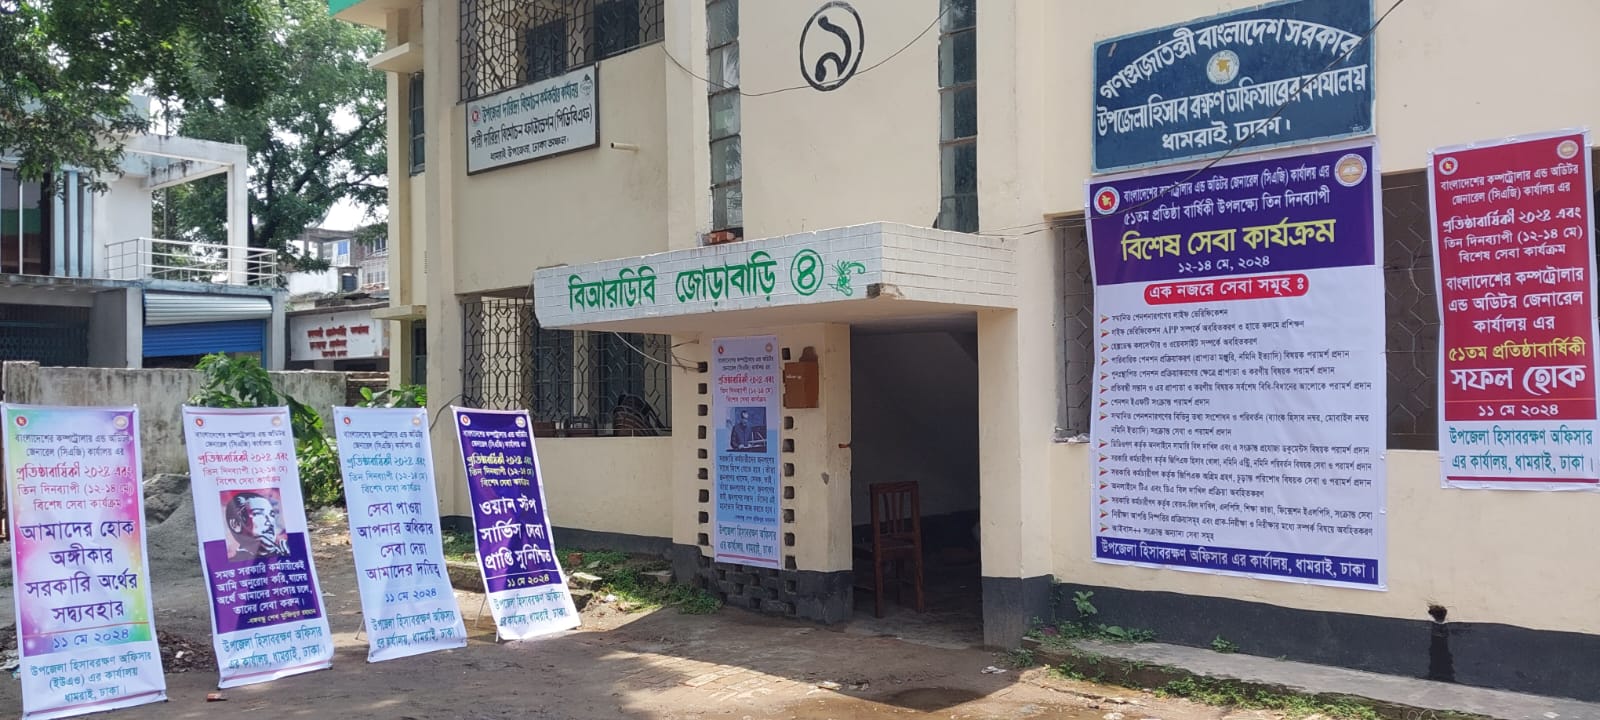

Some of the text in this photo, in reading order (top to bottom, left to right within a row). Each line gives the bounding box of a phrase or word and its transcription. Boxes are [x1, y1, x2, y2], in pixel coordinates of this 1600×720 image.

[808, 9, 858, 86] ৯
[1197, 18, 1283, 50] বাংলাদেশ
[1286, 19, 1363, 61] সরকার
[554, 104, 592, 132] (পিডিবিএফ)
[1097, 101, 1148, 136] উপজেলা
[1148, 93, 1188, 128] হিসাব
[1190, 90, 1225, 120] রক্ষণ
[1226, 77, 1300, 112] অফিসারের
[1124, 188, 1158, 202] বাংলাদেশের
[1194, 182, 1206, 192] এন্ড
[1207, 176, 1229, 190] অডিটর
[1230, 174, 1258, 188] জেনারেল
[1261, 170, 1288, 189] (সিএজি)
[1290, 166, 1316, 182] কার্যালয়
[1318, 165, 1330, 178] এর
[1440, 164, 1578, 192] বাংলাদেশের কম্পট্রোলার এন্ড অডিটর
[1124, 210, 1149, 226] ৫১তম
[1152, 203, 1180, 222] প্রতিষ্ঠা
[1184, 199, 1214, 219] বার্ষিকী
[1262, 192, 1281, 208] তিন
[1285, 185, 1330, 206] দিনব্যাপী
[1452, 182, 1570, 206] জেনারেল (সিএজি) কার্যালয় এর
[1443, 207, 1581, 233] প্রতিষ্ঠাবার্ষিকী ২০২৪ এবং
[1121, 217, 1336, 262] বিশেষ সেবা কার্যক্রম
[1444, 226, 1582, 250] তিন দিনব্যাপী (১২-১৪ মে)
[1458, 242, 1566, 263] বিশেষ সেবা কার্যক্রম
[1178, 256, 1270, 274] ১২-১৪ মে, ২০২৪
[568, 251, 820, 312] বিআরডিবি জোড়াবাড়ি ৪
[1150, 278, 1290, 300] এক নজরে সেবা সমূহ
[1446, 266, 1584, 291] বাংলাদেশের কম্পট্রোলার
[1448, 290, 1584, 312] এন্ড অডিটর জেনারেল
[1163, 326, 1178, 334] APP
[1473, 314, 1556, 334] কার্যালয় এর
[1449, 336, 1586, 362] ৫১তম প্রতিষ্ঠাবার্ষিকী
[1451, 365, 1587, 396] সফল হোক
[1478, 404, 1559, 416] ১১ মে ২০২৪
[1450, 424, 1592, 446] উপজেলা হিসাবরক্ষণ অফিসার
[1452, 455, 1466, 470] এর
[1470, 450, 1512, 473] কার্যালয়,
[1516, 452, 1556, 473] ধামরাই,
[368, 502, 394, 518] সেবা
[480, 494, 538, 514] ওয়ান স্টপ
[20, 520, 134, 540] আমাদের হোক
[356, 518, 434, 539] আপনার অধিকার
[480, 518, 522, 544] সার্ভিস
[50, 542, 113, 566] অঙ্গীকার
[381, 543, 406, 558] সেবা
[485, 547, 514, 570] প্রাপ্তি
[1102, 538, 1137, 554] উপজেলা
[1140, 542, 1186, 562] হিসাবরক্ষণ
[1189, 546, 1228, 564] অফিসার
[1232, 553, 1246, 566] এর
[1250, 552, 1292, 574] কার্যালয়,
[1296, 558, 1336, 578] ধামরাই,
[238, 562, 266, 576] সরকারি
[365, 564, 413, 580] আমাদের
[25, 568, 138, 598] সরকারি অর্থের
[216, 580, 237, 592] আমি
[238, 589, 270, 601] আমাদের
[385, 588, 437, 602] ১১ মে ২০২৪
[232, 604, 257, 614] তাদের
[260, 601, 278, 612] সেবা
[52, 629, 129, 648] ১১ মে ২০২৪
[30, 651, 152, 676] উপজেলা হিসাবরক্ষণ অফিসার
[88, 673, 102, 682] এর
[105, 667, 138, 679] কার্যালয়
